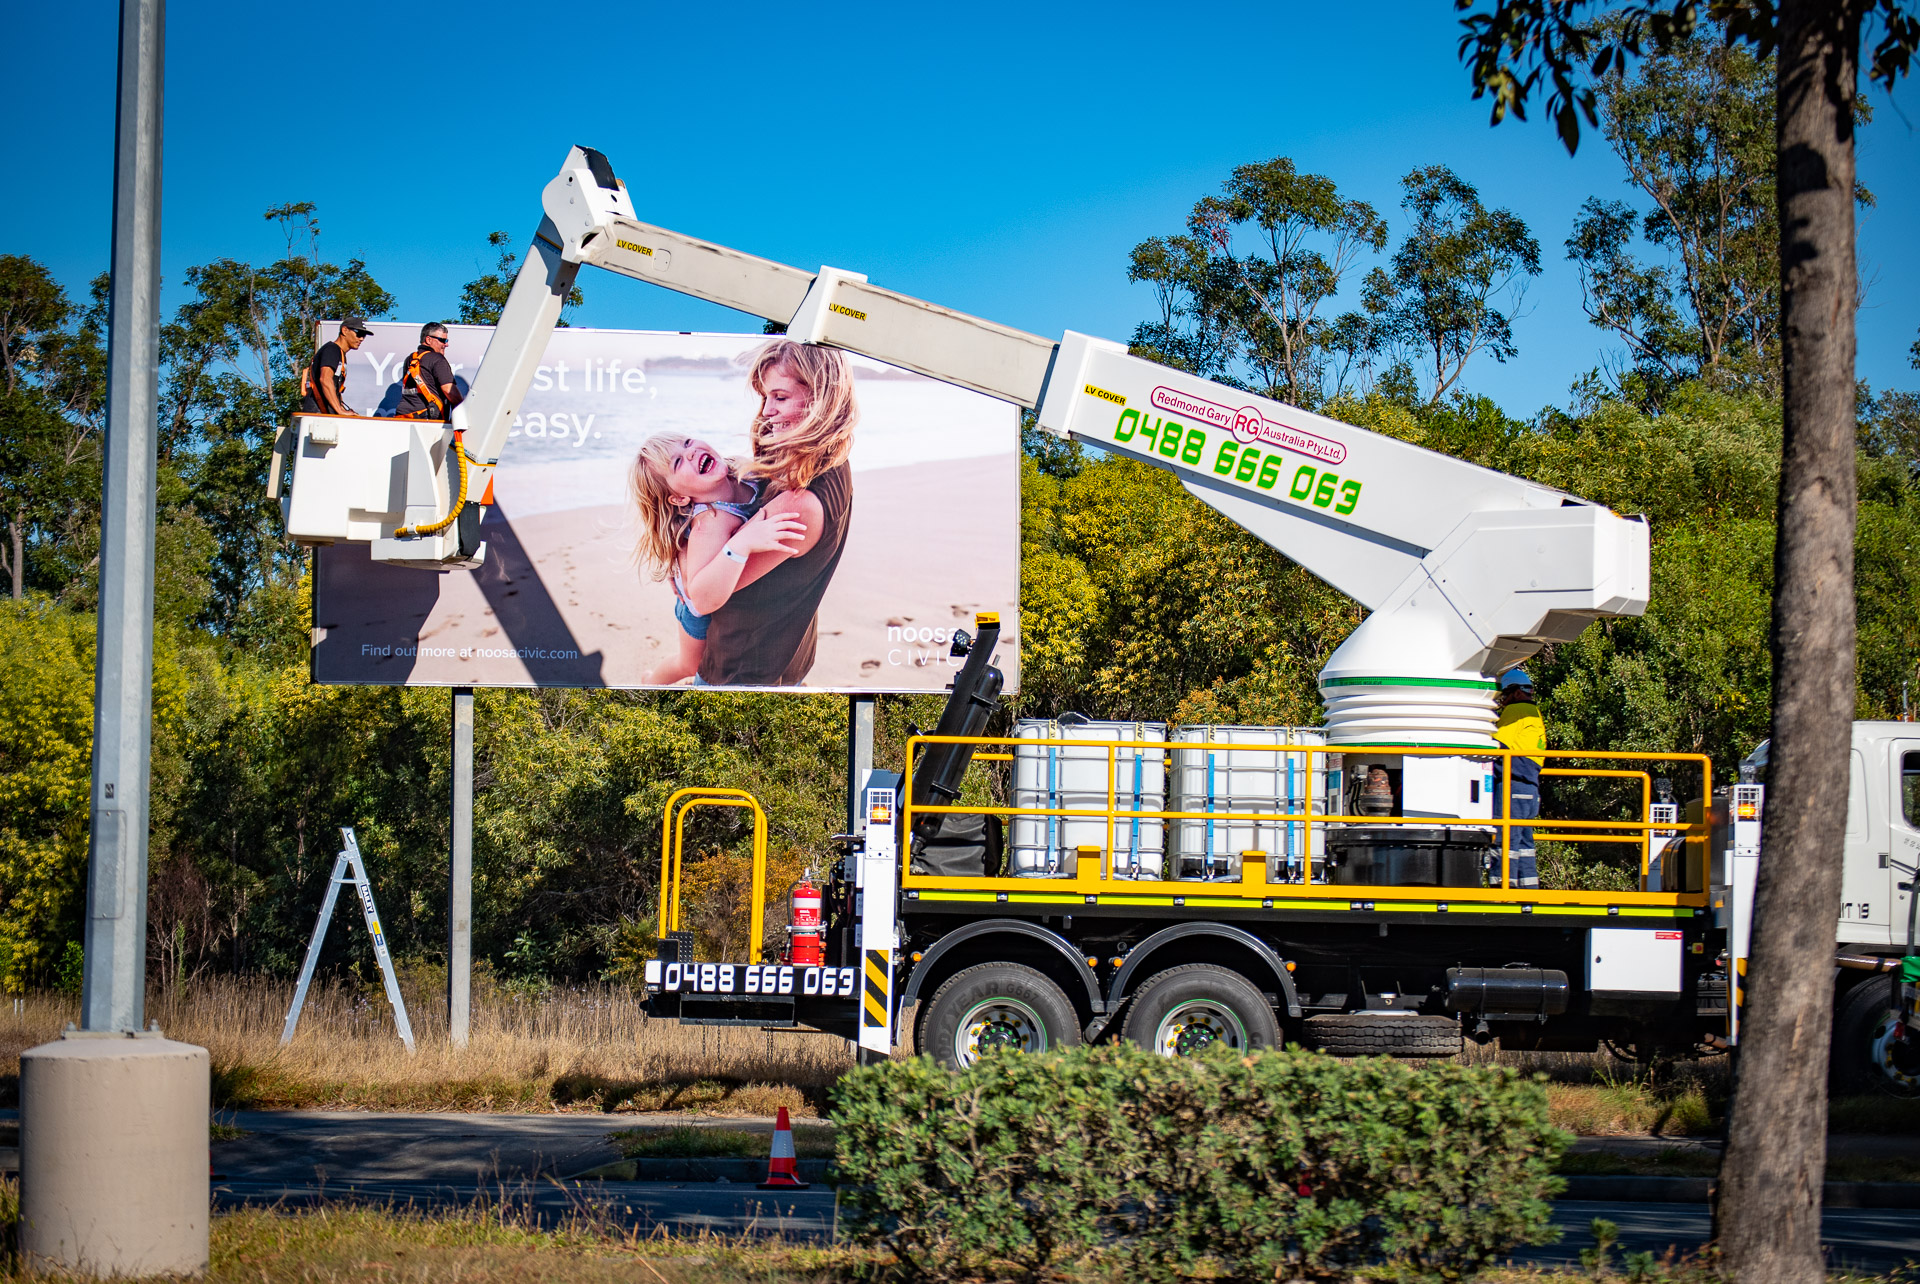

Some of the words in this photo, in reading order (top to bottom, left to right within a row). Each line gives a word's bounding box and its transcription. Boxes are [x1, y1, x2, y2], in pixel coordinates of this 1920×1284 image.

[617, 240, 626, 248] LV
[627, 242, 652, 256] COVER
[829, 303, 839, 312] LV
[839, 306, 866, 321] COVER
[585, 357, 658, 399] life,
[1085, 385, 1096, 395] LV
[1097, 390, 1126, 405] COVER
[1157, 392, 1206, 416] Redmond
[1206, 407, 1231, 426] Gary
[1234, 414, 1260, 436] RG
[1263, 426, 1306, 448] Australia
[1113, 407, 1207, 466] 0488
[1213, 440, 1283, 490] 666
[1288, 465, 1363, 516] 063
[361, 644, 391, 657] Find
[394, 645, 417, 657] out
[421, 647, 456, 658] more
[459, 646, 472, 658] at
[476, 647, 578, 660] noosacivic.com
[361, 885, 374, 912] BAILEY
[664, 963, 735, 993] 0488
[744, 965, 794, 994] 666
[803, 967, 855, 996] 063
[1006, 983, 1039, 1002] G667
